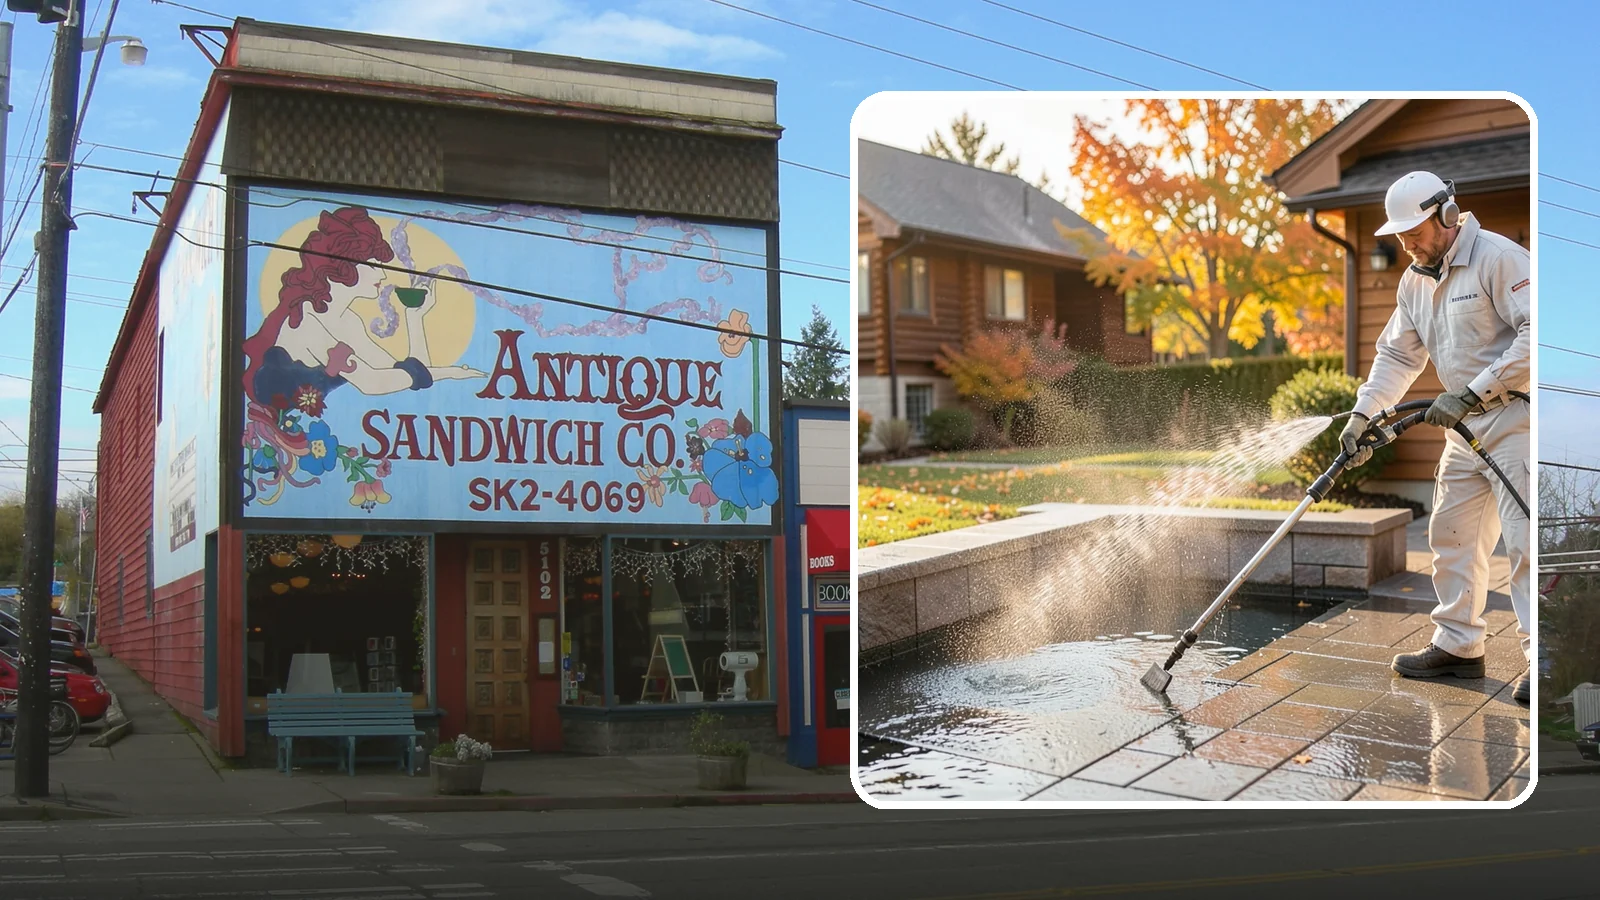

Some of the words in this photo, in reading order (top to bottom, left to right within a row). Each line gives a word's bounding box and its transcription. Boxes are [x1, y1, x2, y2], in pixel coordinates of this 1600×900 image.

[476, 330, 723, 421] ANTIQUE
[361, 409, 605, 468] SANDWICH
[617, 422, 686, 469] CO.
[468, 478, 645, 513] SK2-4069
[540, 541, 551, 600] 5102
[809, 555, 835, 569] BOOKS
